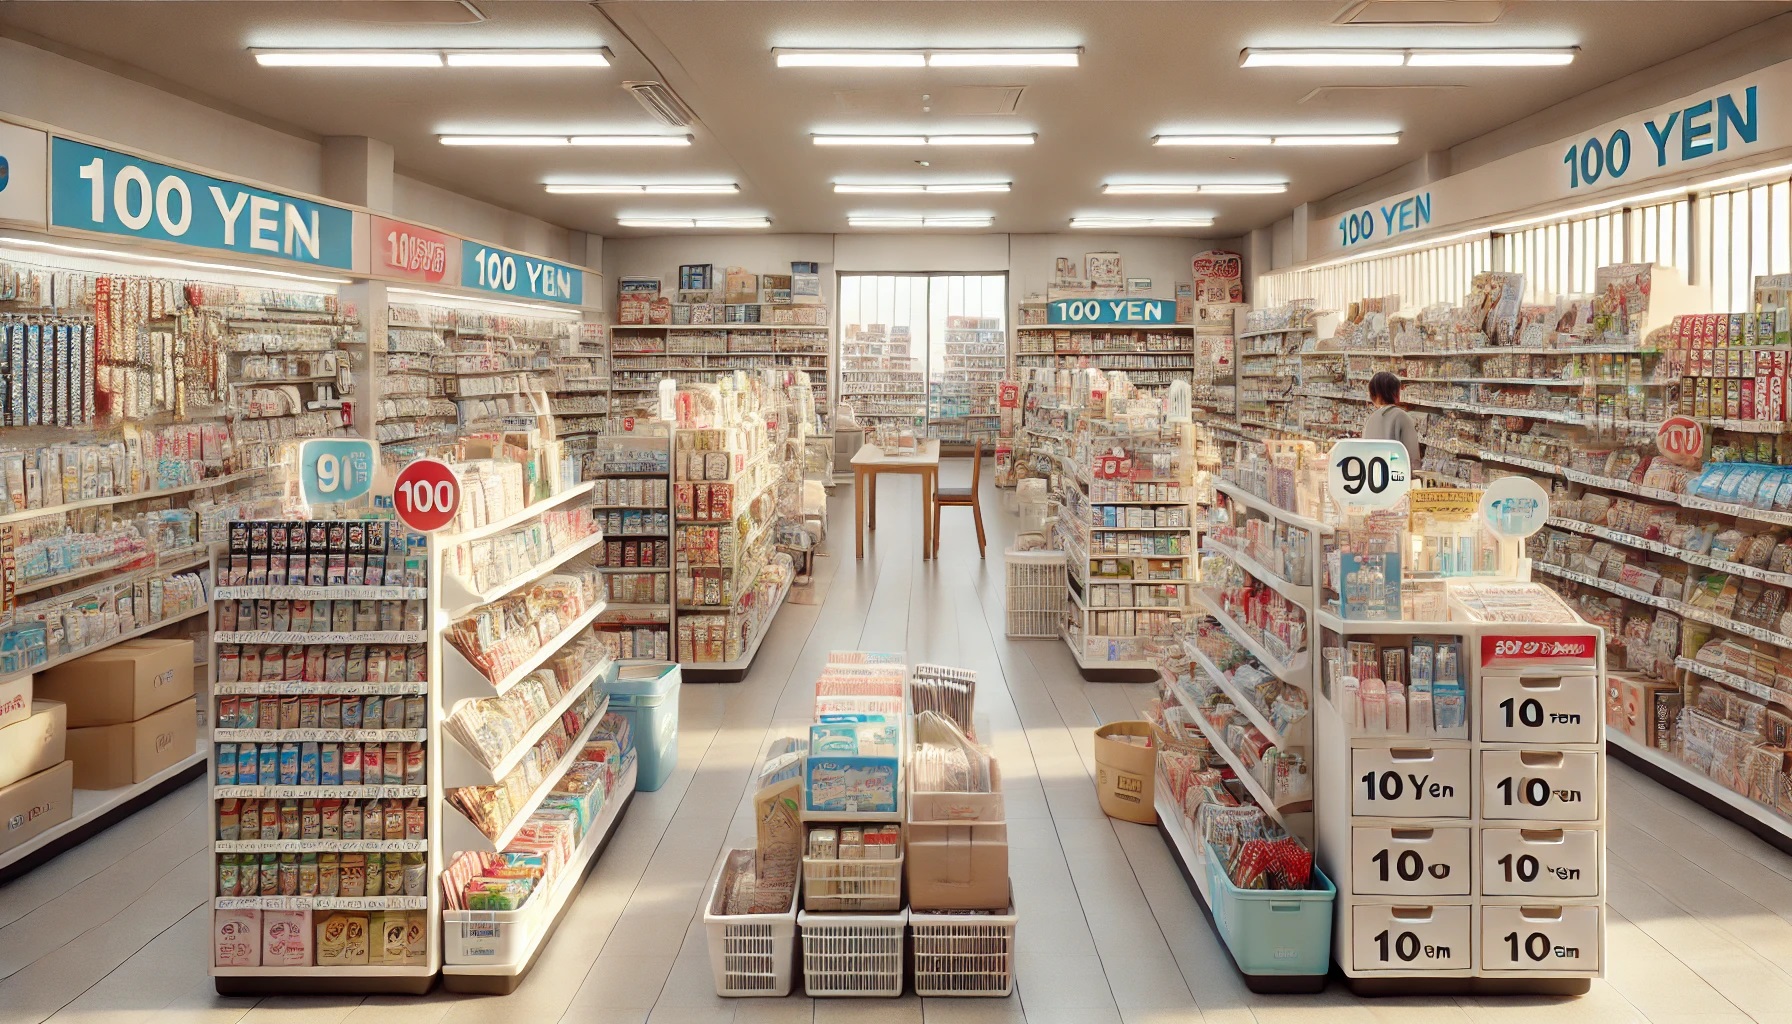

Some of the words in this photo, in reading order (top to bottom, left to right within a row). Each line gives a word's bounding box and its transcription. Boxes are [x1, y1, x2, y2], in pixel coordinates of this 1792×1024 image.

[1564, 129, 1631, 188] 100
[1644, 86, 1757, 167] YEN
[79, 157, 192, 236] 100
[208, 185, 320, 259] YEN
[1339, 210, 1374, 246] 100
[1380, 192, 1431, 236] YEN
[474, 248, 517, 291] 100
[526, 261, 571, 299] YEN
[1057, 300, 1101, 321] 100
[1110, 300, 1162, 321] YEN
[1336, 456, 1389, 494] 90
[398, 479, 454, 513] 100
[1499, 697, 1544, 728] 10
[1361, 770, 1404, 801] 10
[1408, 774, 1454, 801] Yen
[1497, 776, 1550, 807] 10
[1372, 848, 1424, 882] 10
[1497, 853, 1540, 882] 10
[1374, 929, 1421, 962] 10
[1504, 931, 1551, 962] 10
